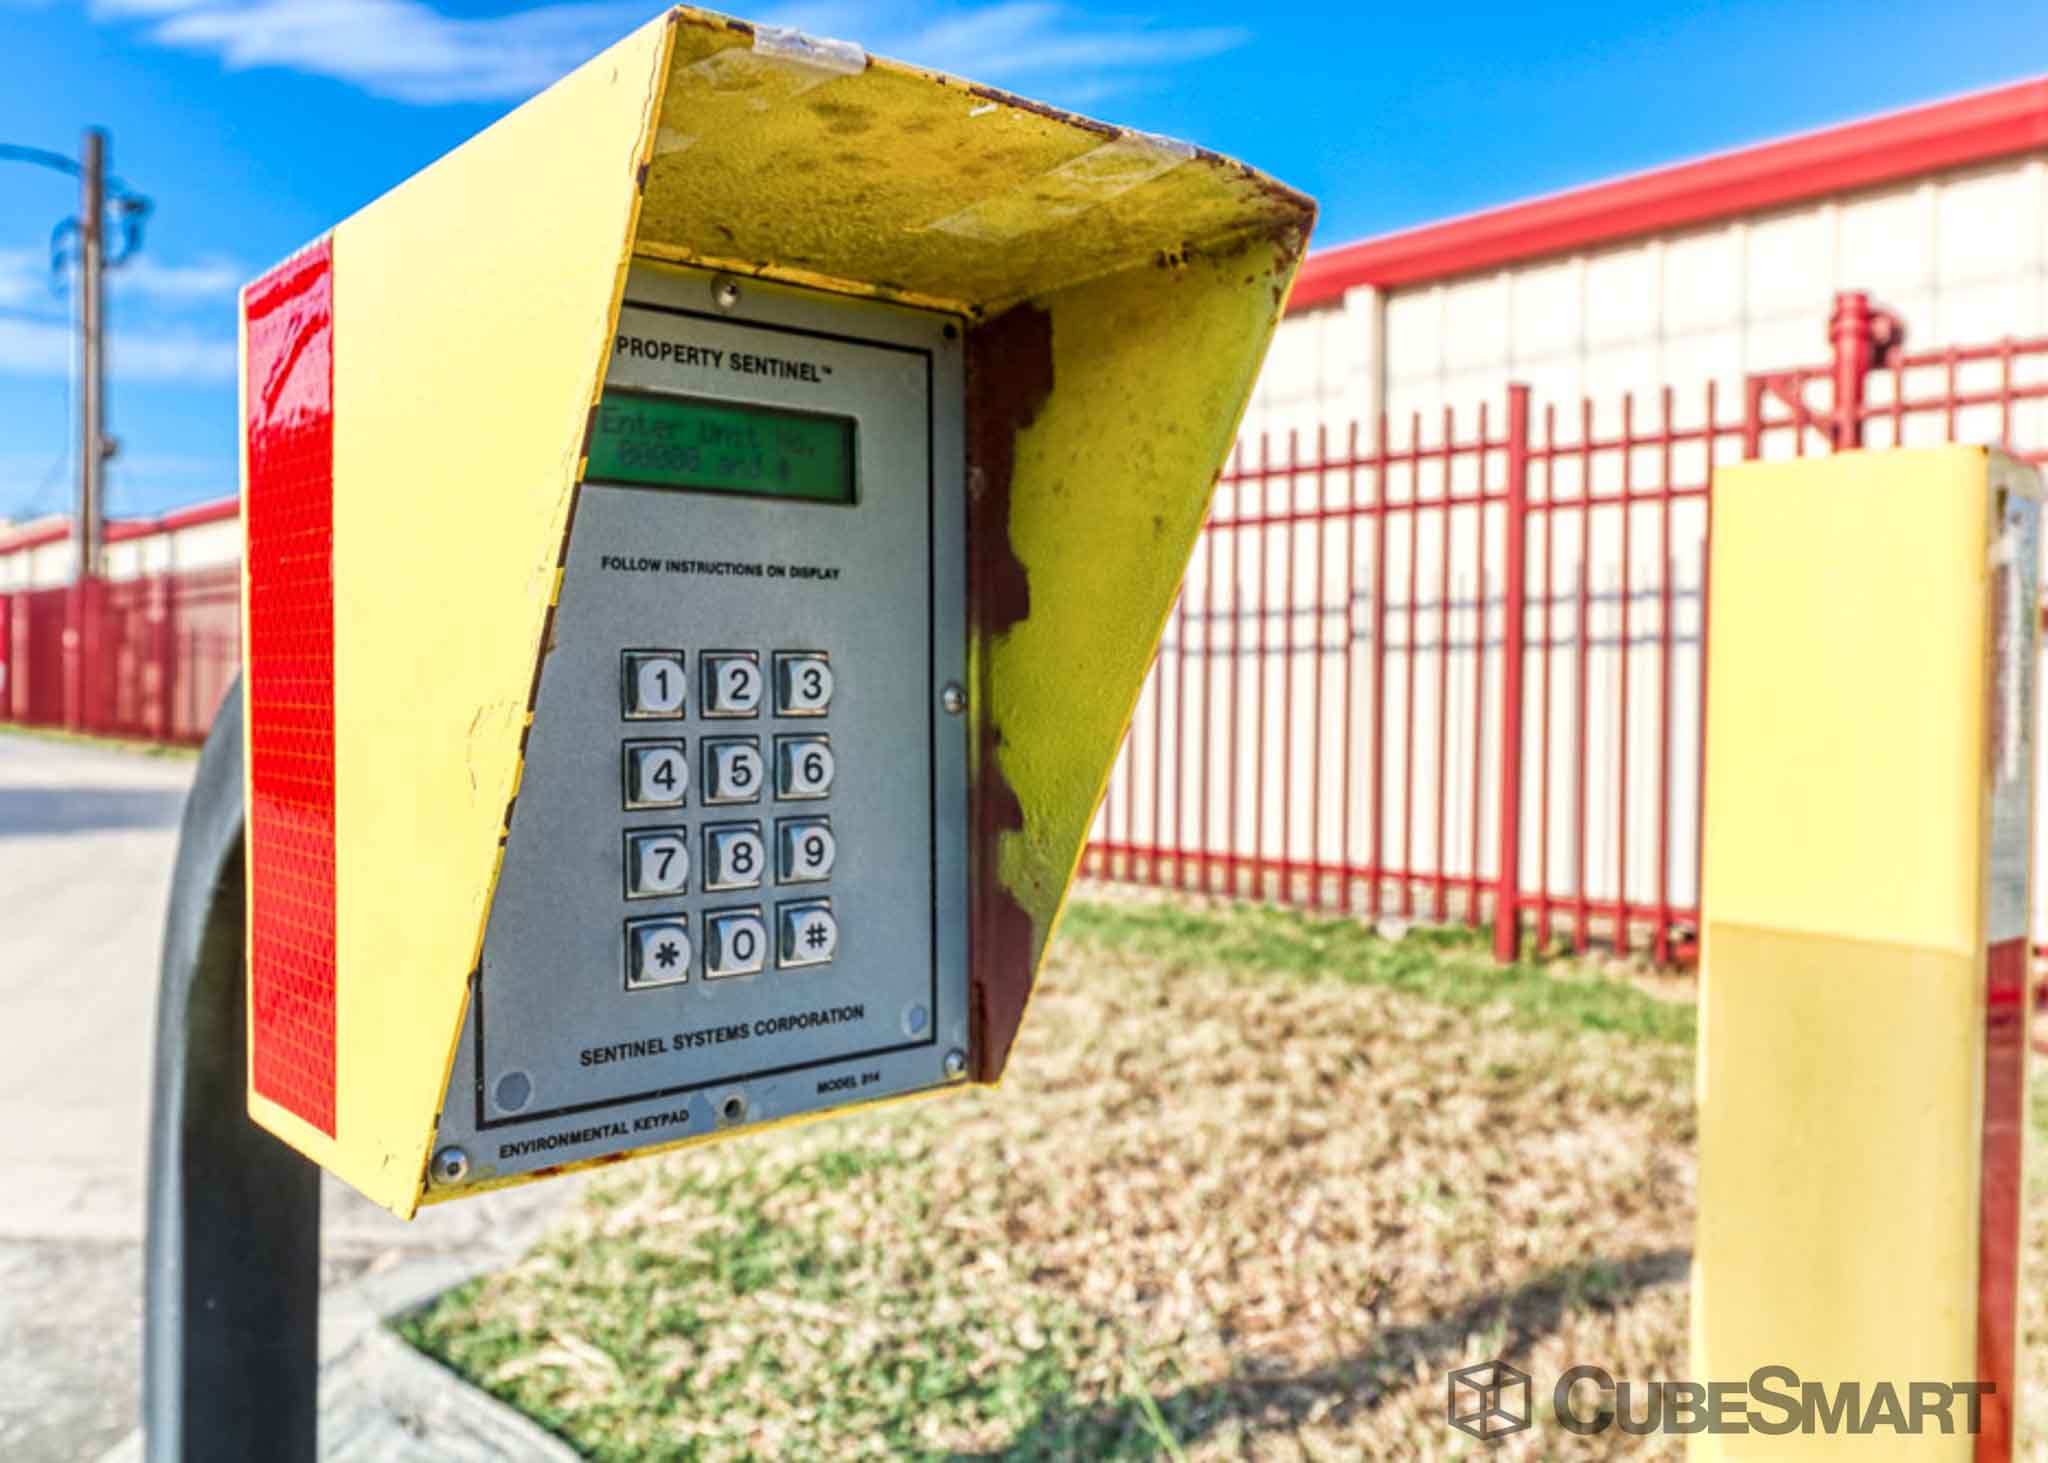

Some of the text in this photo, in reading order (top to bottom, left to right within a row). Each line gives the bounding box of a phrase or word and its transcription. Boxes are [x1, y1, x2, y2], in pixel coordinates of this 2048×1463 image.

[616, 335, 724, 369] PROPERTY
[601, 555, 841, 581] FOLLOW INSTRUCTIONS ON DISPLAY
[655, 668, 822, 702] 1 2 3
[652, 752, 824, 791] 4 5 6
[653, 835, 825, 881] 7 8 9
[732, 928, 755, 961] 0
[805, 922, 828, 949] #
[580, 1004, 865, 1067] SENTINEL SYSTEMS CORPORATION
[816, 1074, 857, 1095] MODEL
[499, 1109, 690, 1159] ENVIRONMENTAL KEYPAD
